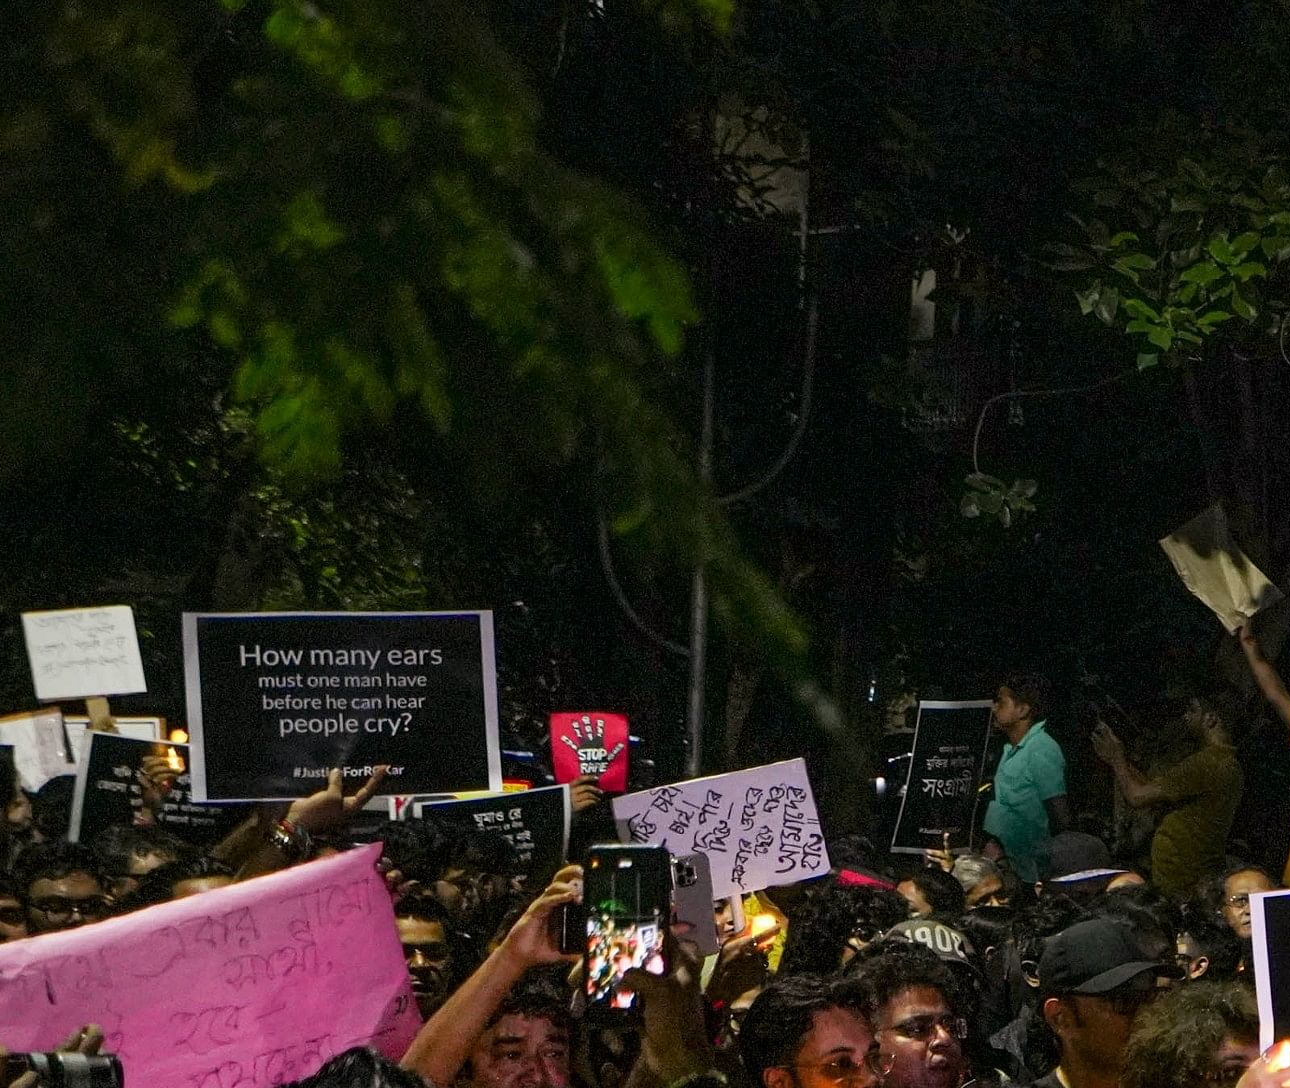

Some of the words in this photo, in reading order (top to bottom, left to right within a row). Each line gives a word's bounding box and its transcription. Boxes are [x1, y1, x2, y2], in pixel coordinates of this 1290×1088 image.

[239, 645, 303, 667] How
[309, 649, 381, 670] many
[387, 649, 443, 666] ears
[258, 674, 304, 688] must
[307, 675, 341, 688] one
[344, 675, 382, 688] man
[386, 672, 428, 688] have
[262, 694, 322, 710] before
[326, 695, 348, 709] he
[351, 698, 382, 710] can
[386, 693, 426, 709] hear
[279, 713, 359, 738] people
[364, 712, 413, 736] cry?
[577, 748, 608, 761] STOP
[580, 762, 610, 775] RAPE
